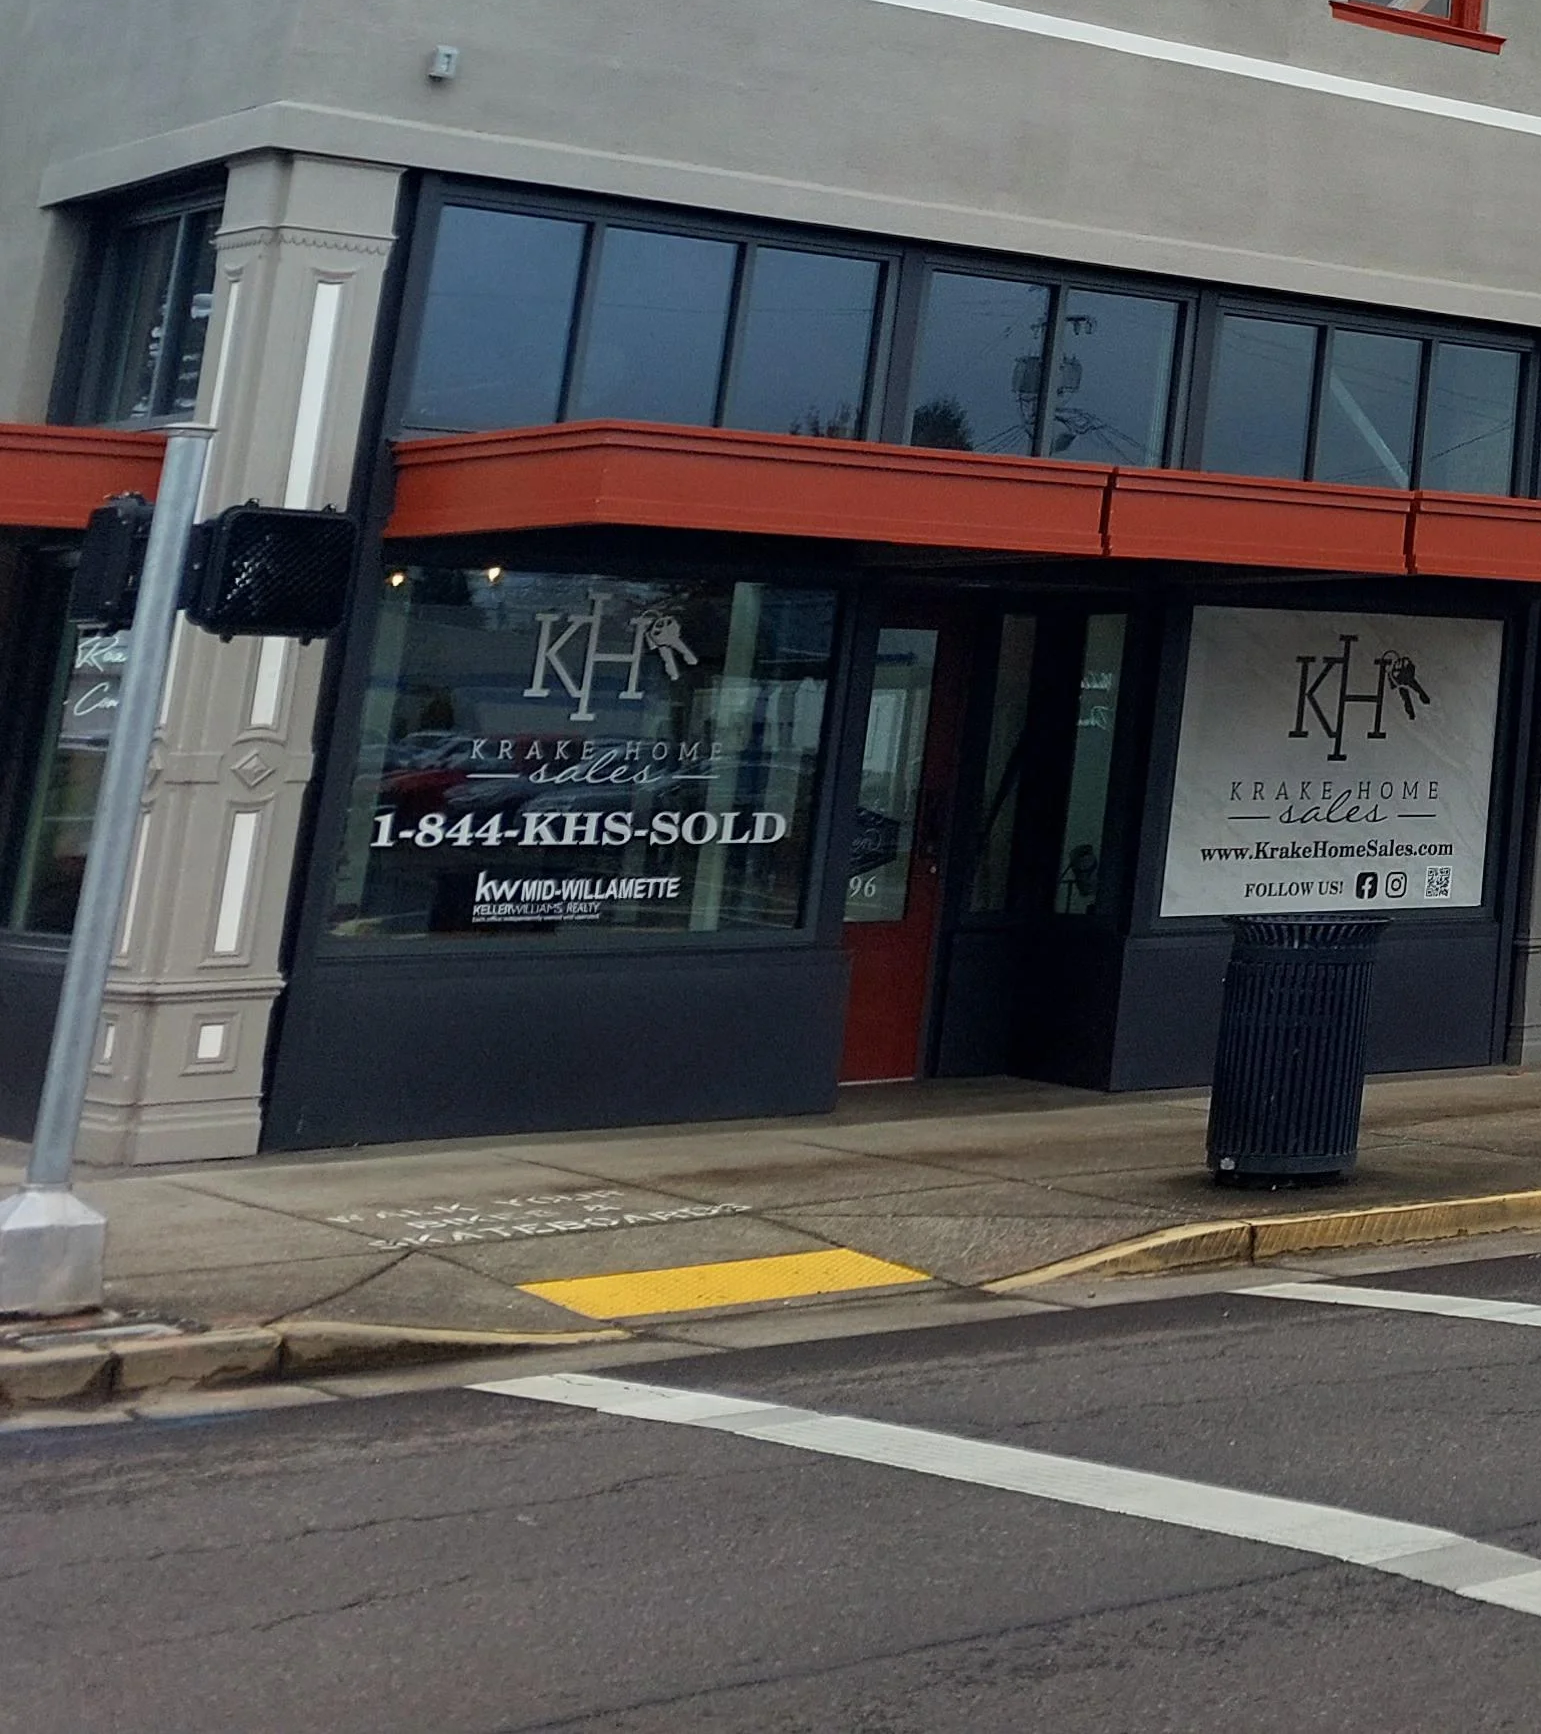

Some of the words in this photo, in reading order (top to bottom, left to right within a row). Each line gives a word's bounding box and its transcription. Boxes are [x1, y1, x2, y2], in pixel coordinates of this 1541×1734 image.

[470, 738, 596, 760] KRAKE
[624, 740, 725, 762] HOME
[529, 749, 662, 784] sales
[1229, 780, 1334, 801] KRAKE
[1357, 780, 1440, 800] HOME
[1279, 788, 1389, 824] sales
[370, 810, 787, 847] 1-844-KHS-SOLD
[1200, 838, 1454, 862] www.KrakeHomeSales.com
[475, 870, 523, 902] kw
[520, 876, 681, 902] MID-WILLAMETTE
[1244, 881, 1314, 898] FOLLOW
[1318, 880, 1344, 895] US!
[566, 901, 602, 914] REALTY
[367, 1202, 753, 1251] SKATEBOARDS
